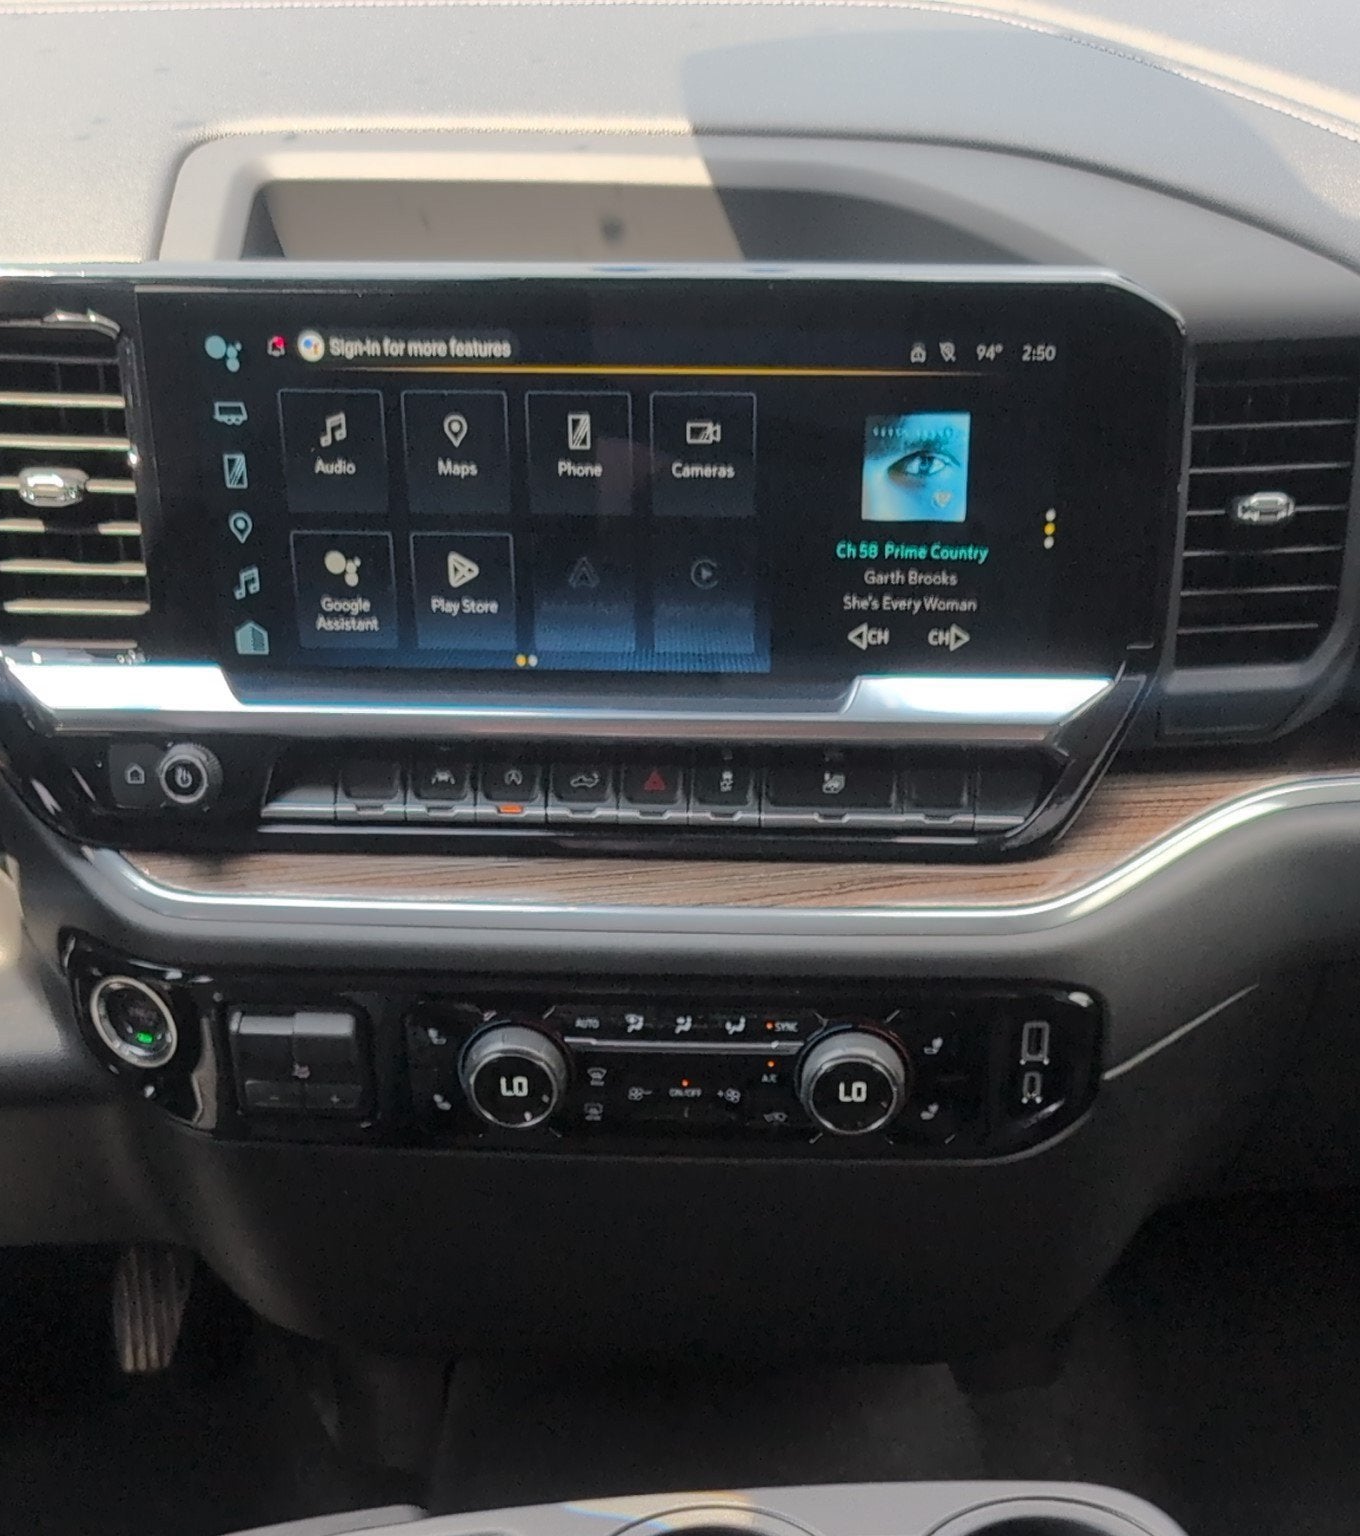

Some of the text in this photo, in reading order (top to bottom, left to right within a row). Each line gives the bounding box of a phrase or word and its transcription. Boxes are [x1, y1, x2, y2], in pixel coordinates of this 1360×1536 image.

[383, 336, 406, 357] for
[408, 338, 447, 358] more
[449, 335, 511, 358] features
[1022, 343, 1056, 361] 2:50
[315, 457, 356, 475] Audio
[438, 458, 478, 479] Maps
[558, 459, 603, 478] Phone
[671, 462, 735, 479] Cameras
[836, 540, 990, 565] Ch 58 Prime Country
[863, 567, 959, 586] Garth Brooks
[321, 595, 371, 616] Google
[430, 596, 499, 617] Play Store
[843, 593, 978, 616] She's Every Woman
[316, 614, 380, 632] Assistant
[867, 627, 890, 646] CH
[928, 628, 950, 647] CH
[575, 1016, 600, 1030] AUTO
[774, 1021, 799, 1034] SYNC
[500, 1075, 529, 1097] LO
[669, 1087, 703, 1099] ON/OFF
[838, 1081, 868, 1103] LO
